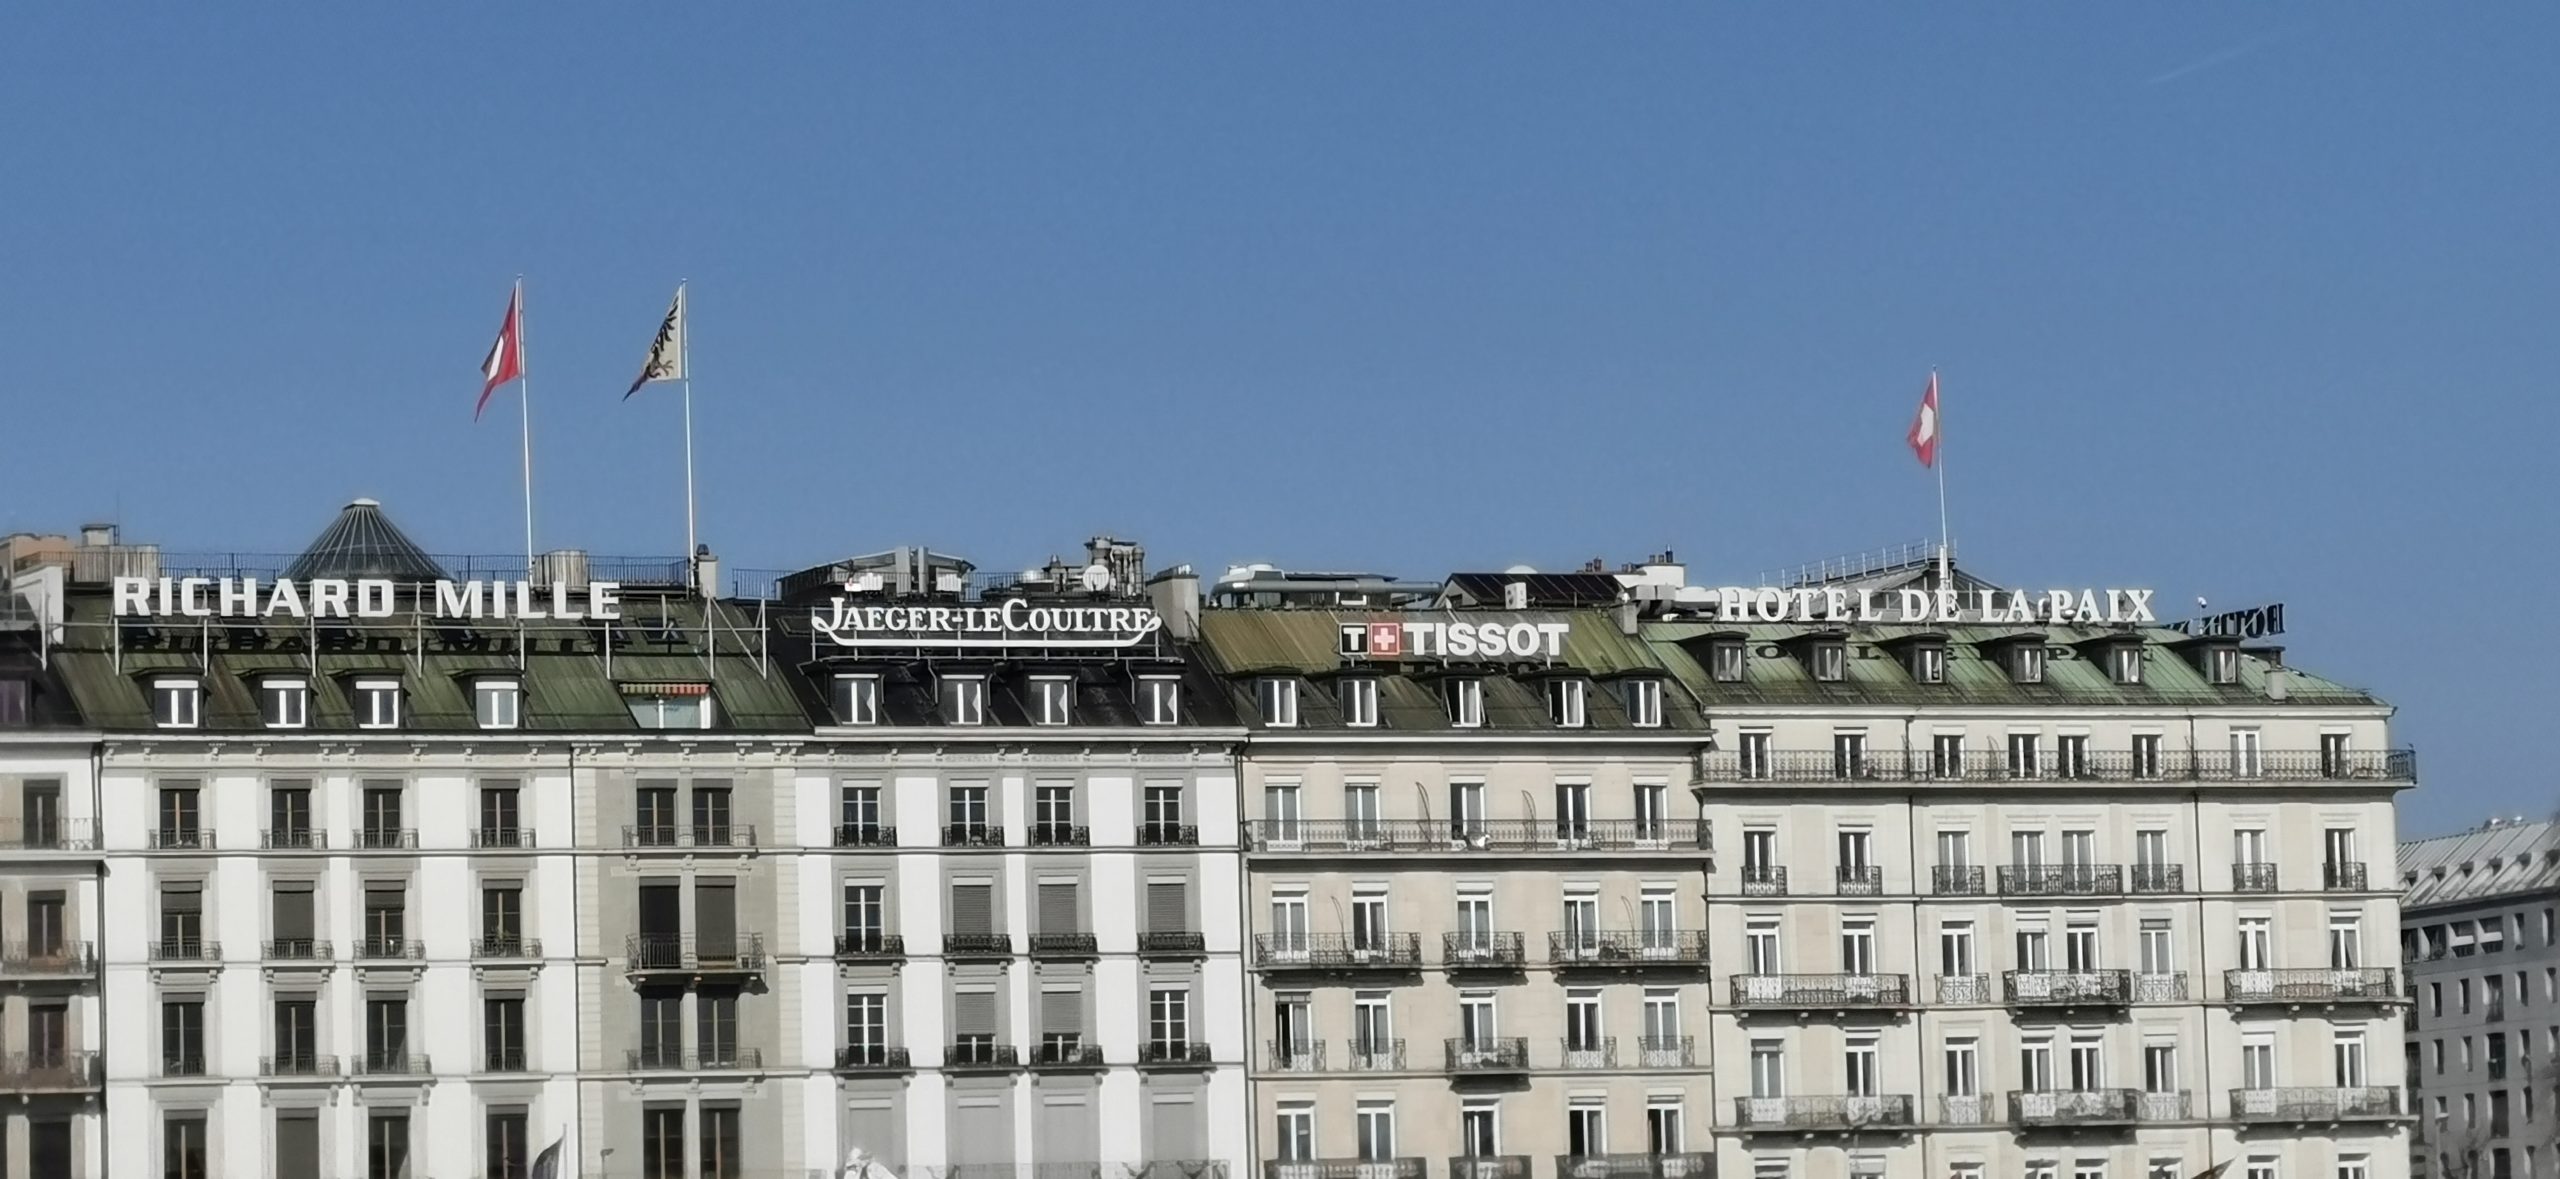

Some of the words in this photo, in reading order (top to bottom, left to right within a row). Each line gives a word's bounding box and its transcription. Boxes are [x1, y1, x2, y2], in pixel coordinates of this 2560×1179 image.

[113, 576, 394, 618] RICHARD
[435, 579, 621, 620] MILLE
[1718, 587, 1883, 622] HOTEL
[1900, 588, 1960, 622] DE
[1979, 588, 2035, 622] LA
[2048, 588, 2156, 622] PAIX
[1402, 622, 1570, 656] TISSOT
